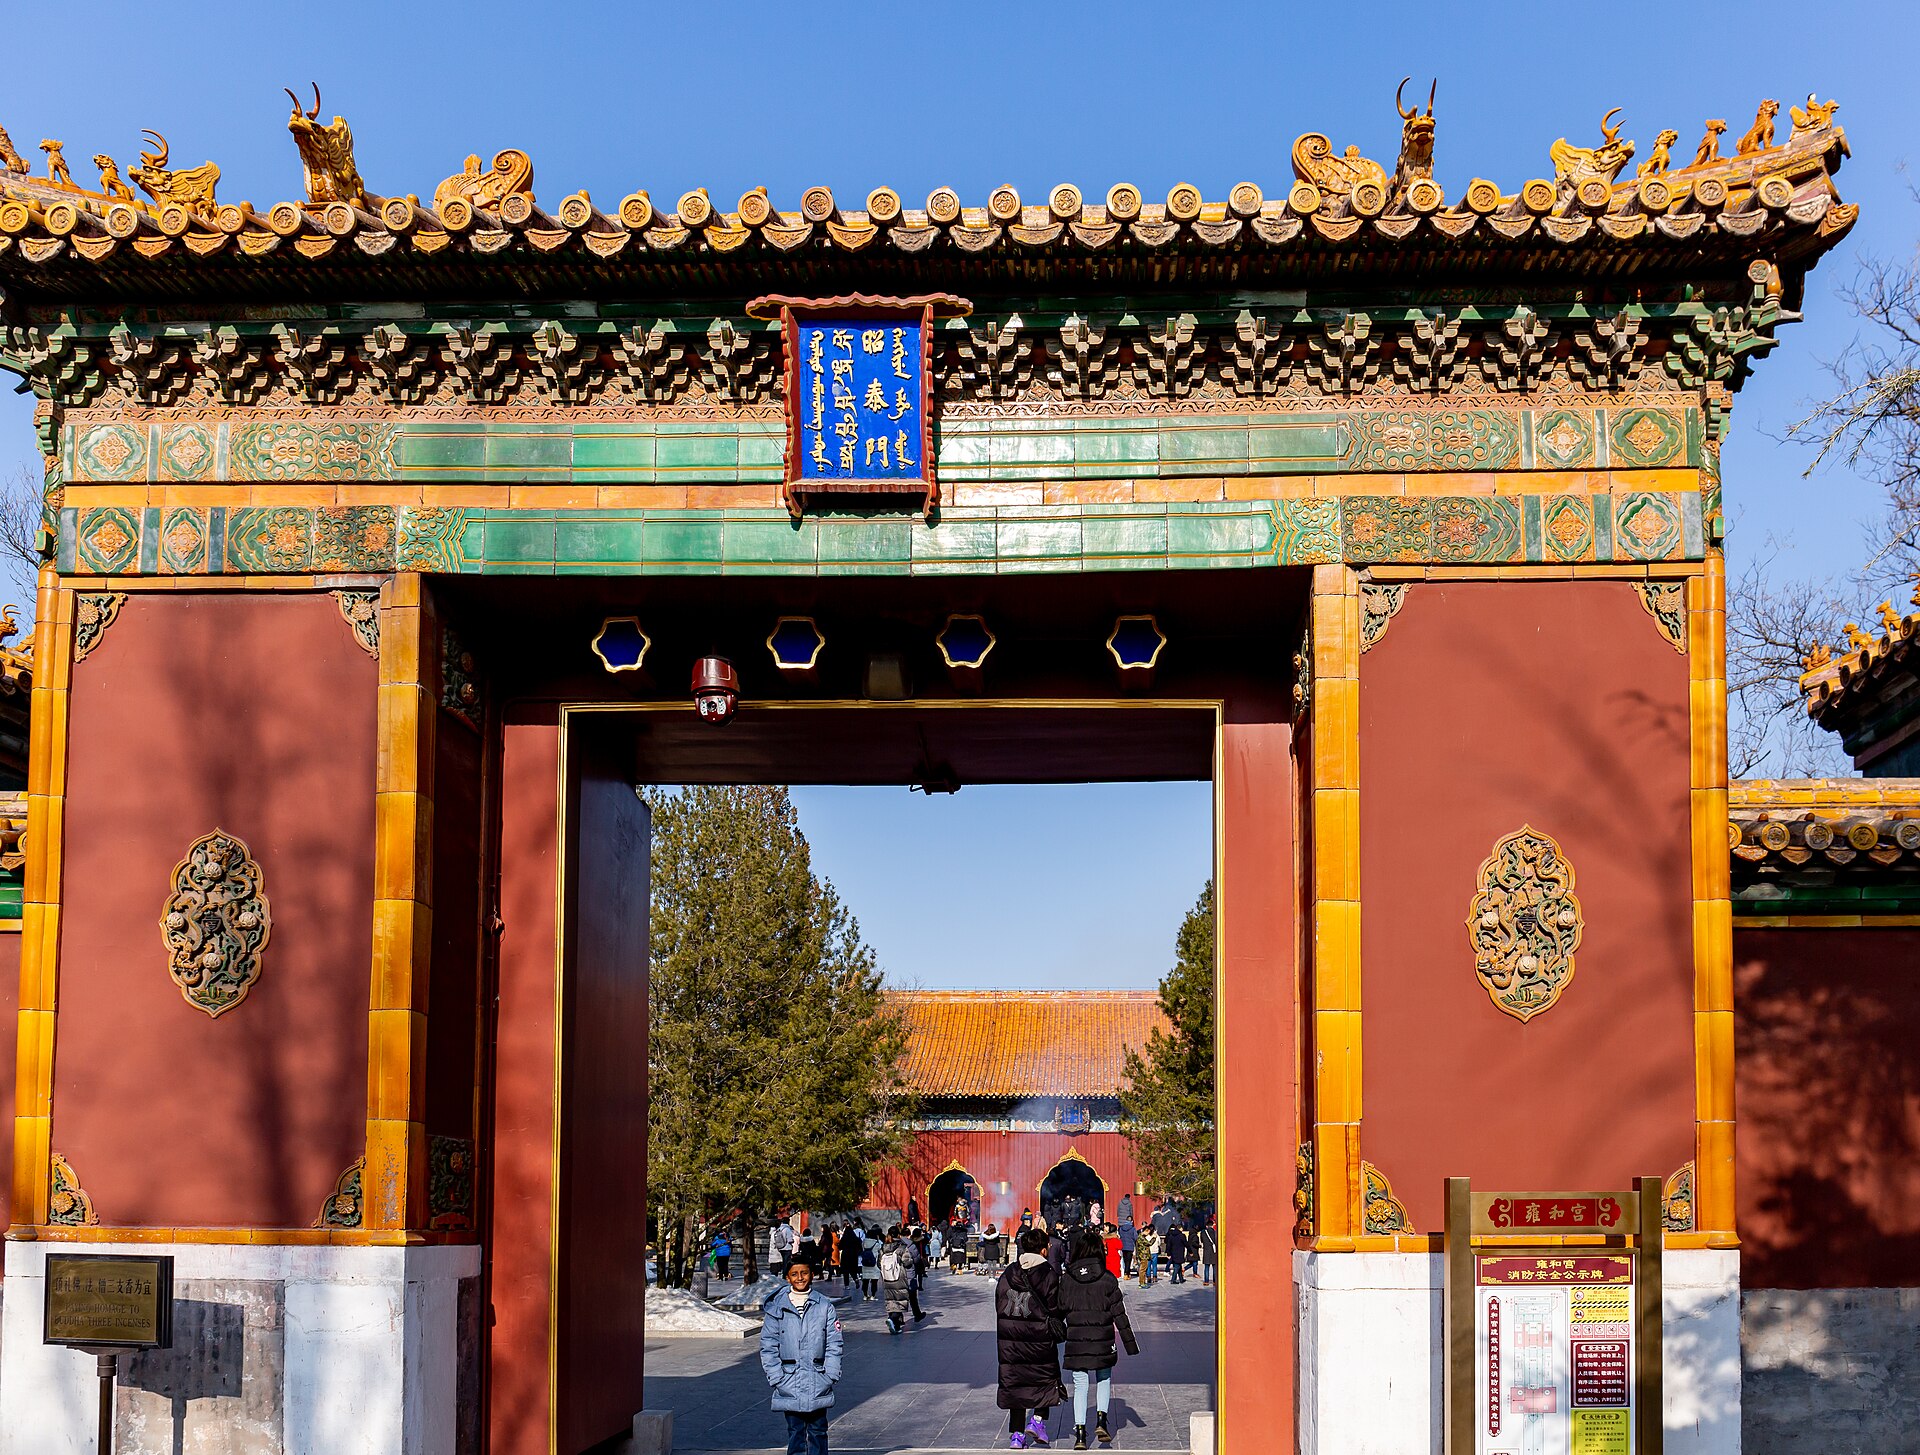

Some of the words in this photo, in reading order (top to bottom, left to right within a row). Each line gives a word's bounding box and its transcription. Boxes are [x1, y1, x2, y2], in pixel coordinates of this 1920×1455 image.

[861, 328, 889, 469] 昭泰門
[1525, 1202, 1587, 1223] 雍和宫
[1535, 1259, 1576, 1269] 雍和宫
[1507, 1269, 1604, 1280] 消防安全公示牌
[94, 1303, 126, 1314] HOMAGE
[129, 1304, 140, 1314] TO
[54, 1315, 84, 1326] BUDDHA
[87, 1315, 112, 1327] THREE
[115, 1317, 152, 1328] INCENSES
